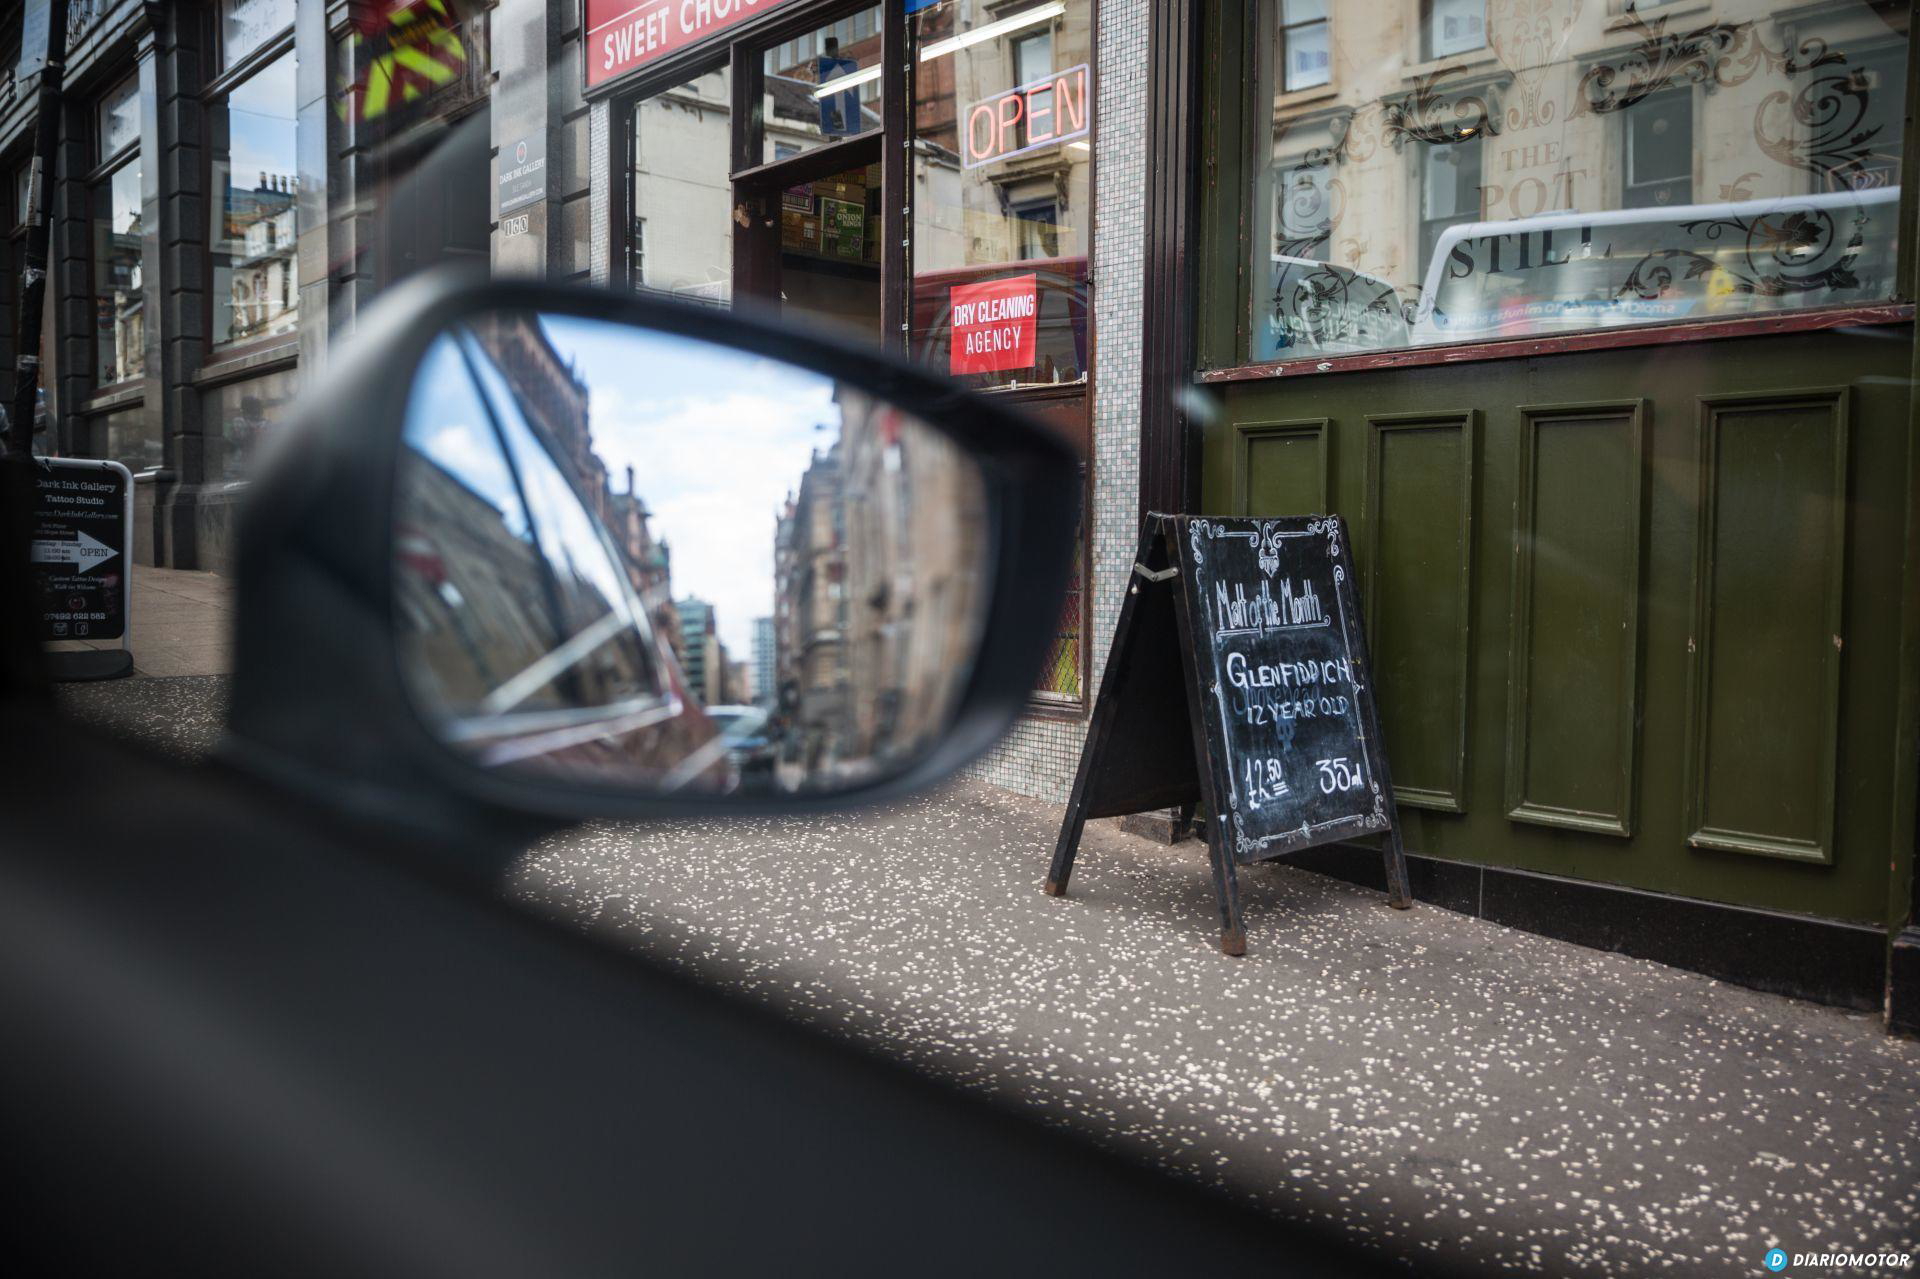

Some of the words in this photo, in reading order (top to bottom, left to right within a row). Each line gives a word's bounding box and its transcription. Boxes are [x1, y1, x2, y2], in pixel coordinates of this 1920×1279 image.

[604, 6, 669, 71] SWEET
[969, 71, 1084, 160] OPEN
[1501, 141, 1560, 171] THE
[500, 171, 513, 185] DARK
[522, 157, 545, 174] GALLERY
[1472, 168, 1588, 223] POT
[505, 215, 529, 237] 160
[836, 213, 862, 222] ONION
[954, 303, 975, 327] DRY
[978, 294, 1034, 323] CLEANING
[966, 326, 1021, 355] AGENCY
[45, 495, 75, 504] Tattoo
[76, 496, 105, 505] Studio
[62, 481, 79, 491] Ink
[80, 482, 117, 494] Gallery
[80, 548, 108, 557] OPEN
[1215, 579, 1249, 630] Malt
[1260, 579, 1280, 626] the
[1280, 577, 1321, 624] Month
[1247, 704, 1268, 725] 12
[1267, 700, 1317, 722] YEAR
[1320, 695, 1351, 715] OLD
